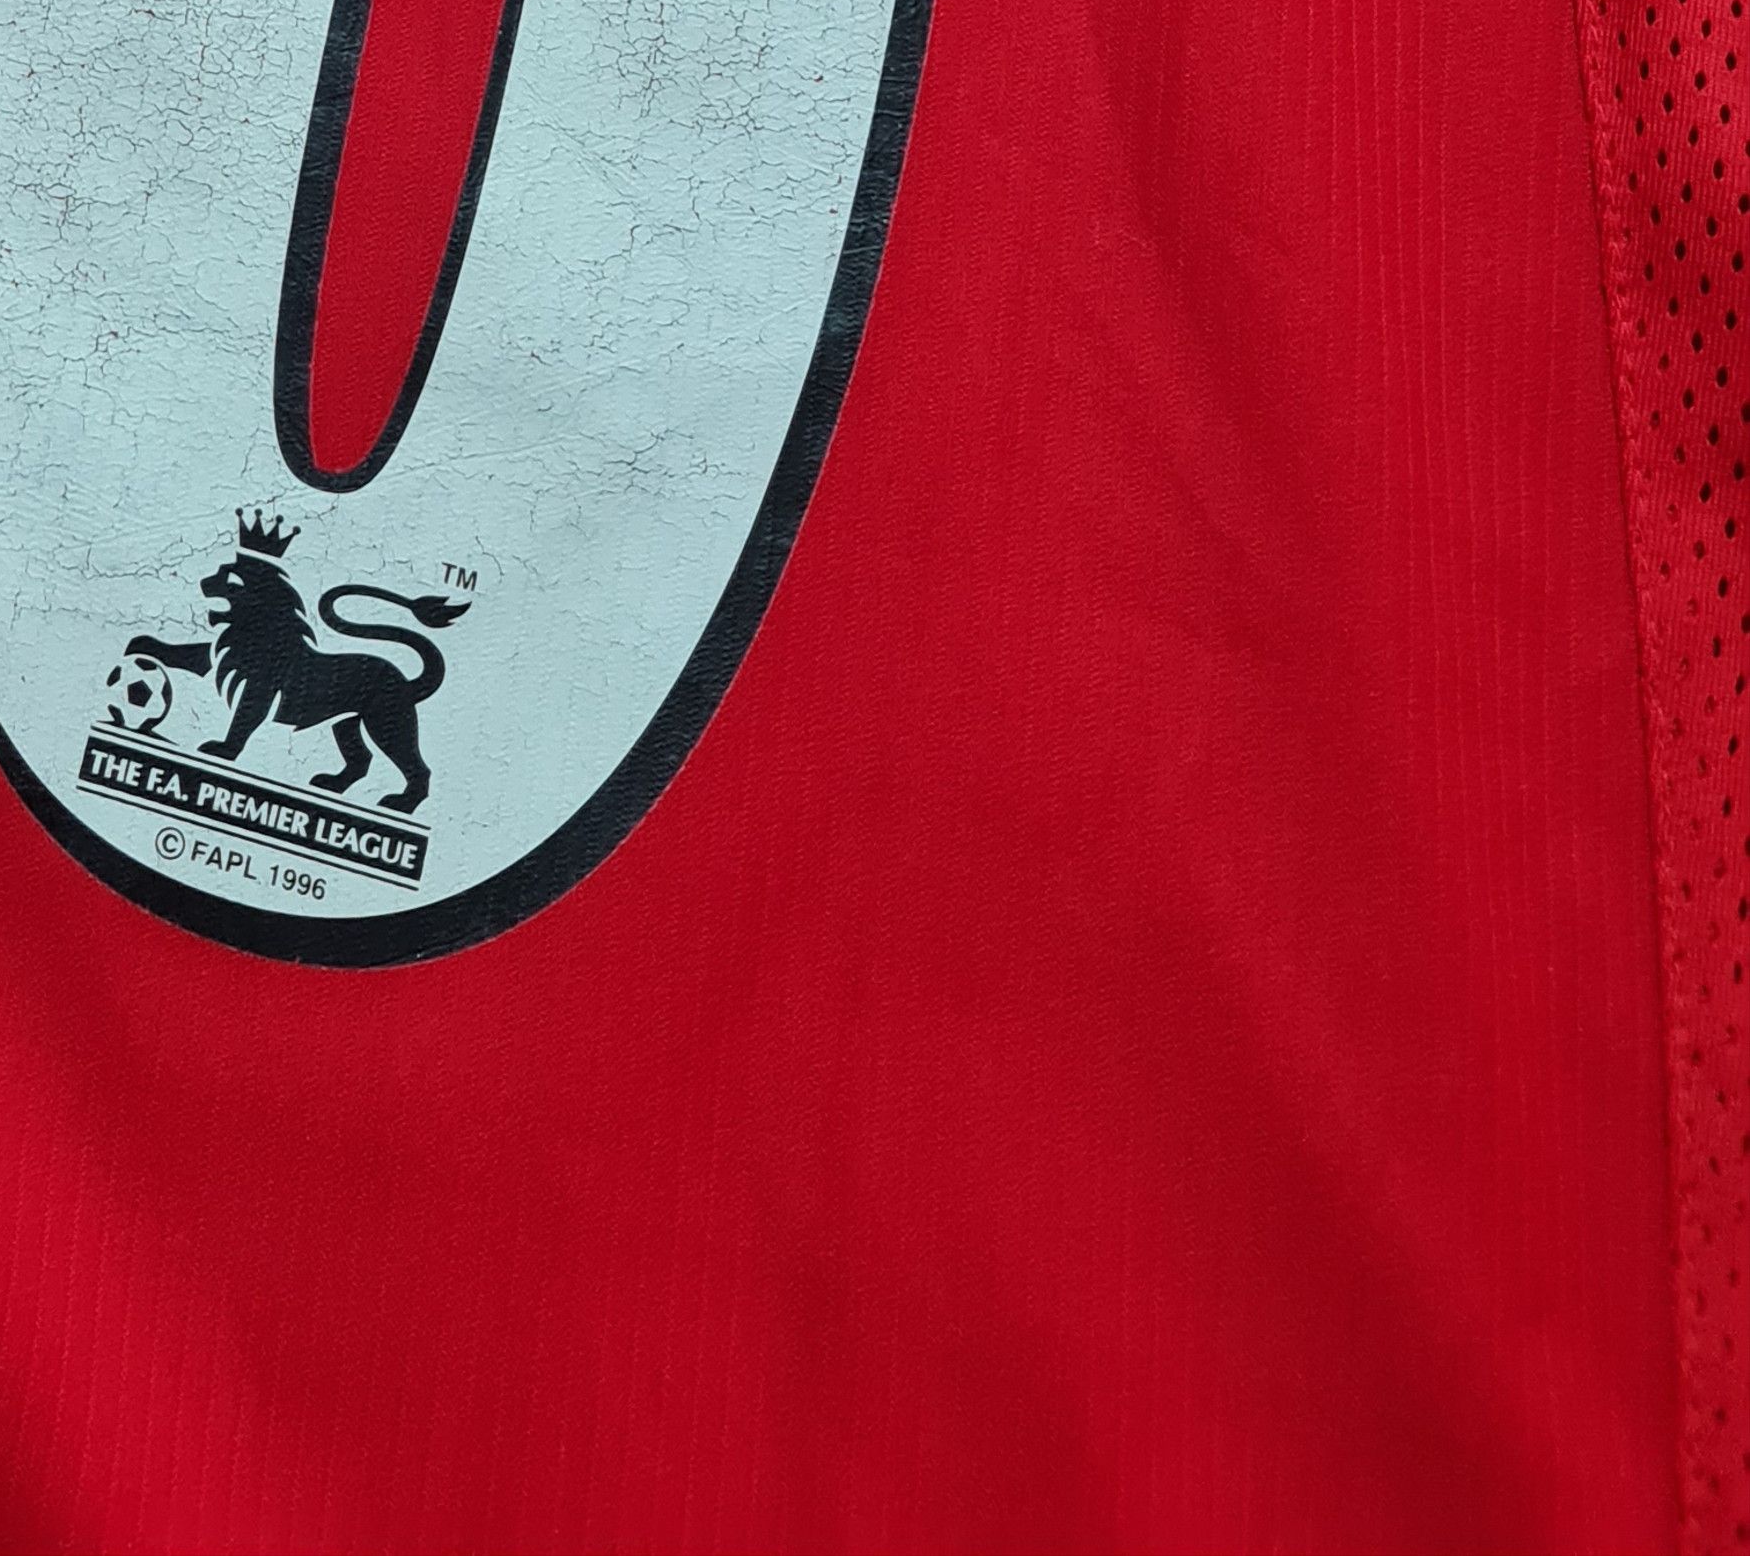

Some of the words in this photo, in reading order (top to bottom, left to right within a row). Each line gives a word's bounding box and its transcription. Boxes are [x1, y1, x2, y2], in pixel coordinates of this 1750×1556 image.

[441, 562, 478, 591] TM
[90, 749, 141, 784] THE
[148, 768, 189, 801] F.A.
[197, 782, 308, 836] PREMIER
[314, 816, 419, 870] LEAGUE
[269, 864, 327, 900] 1996
